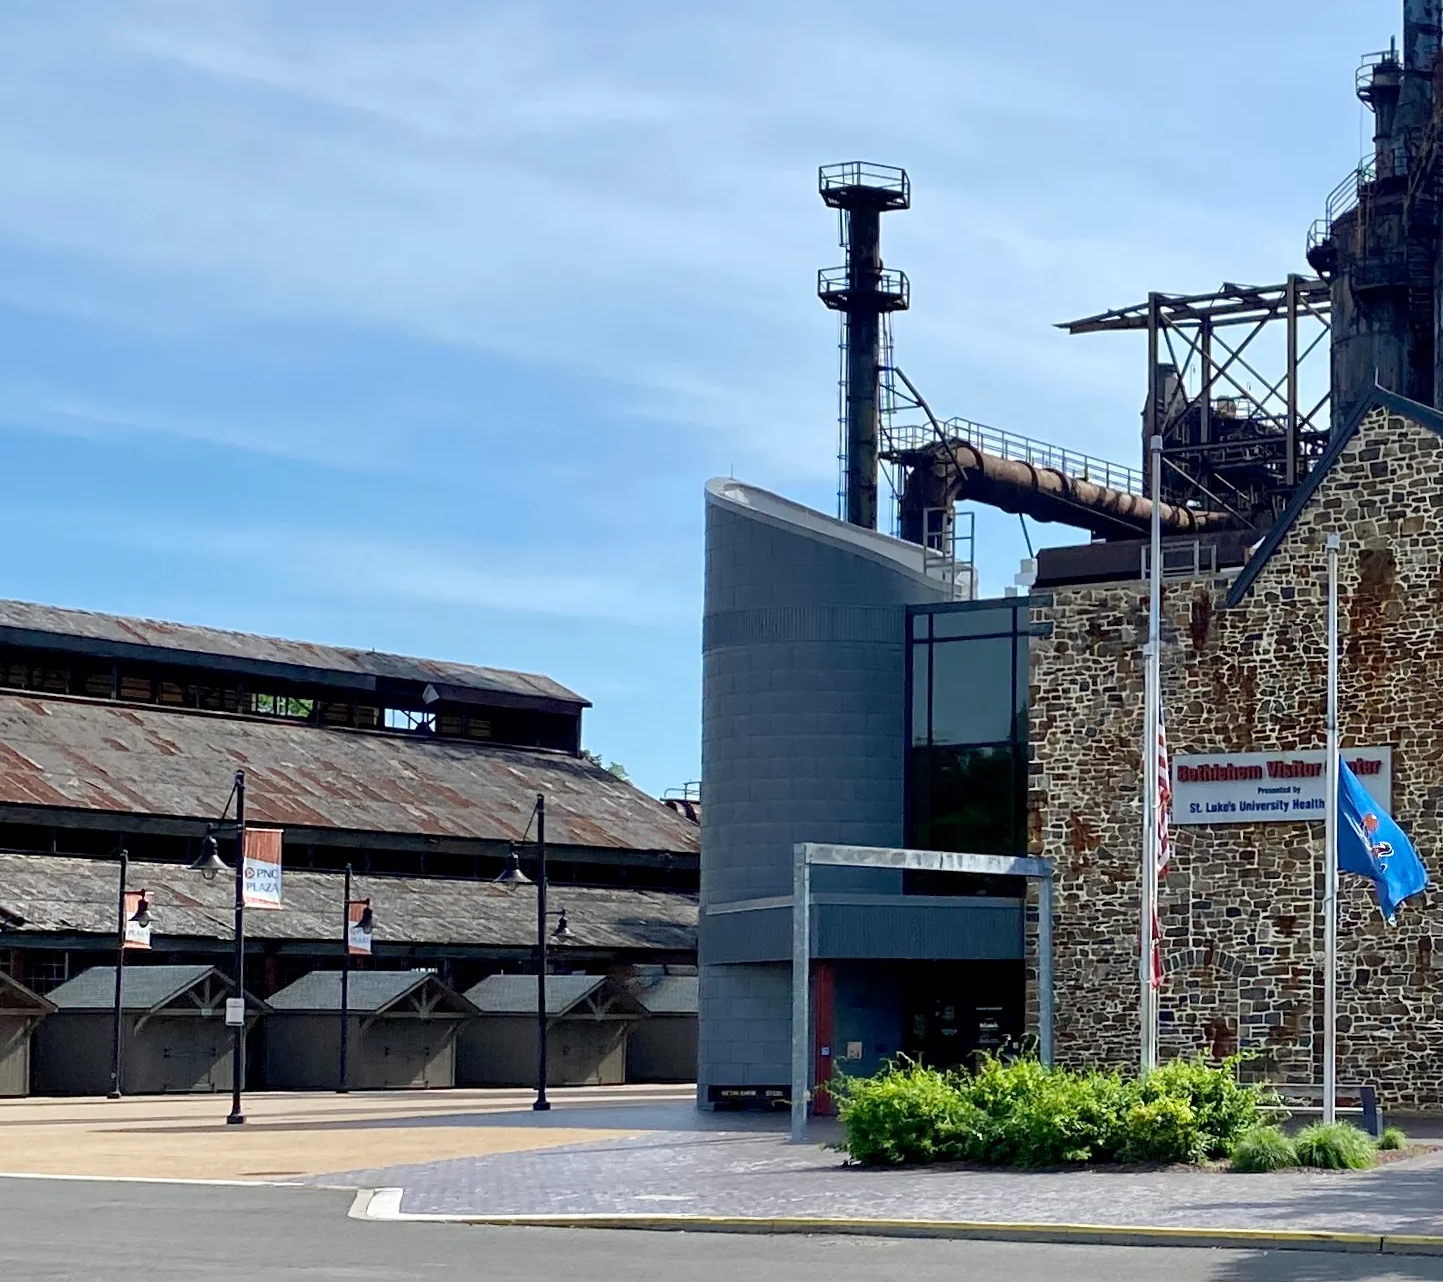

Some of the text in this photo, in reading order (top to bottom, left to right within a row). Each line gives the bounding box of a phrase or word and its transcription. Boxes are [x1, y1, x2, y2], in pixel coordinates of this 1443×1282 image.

[1177, 763, 1263, 782] Bethlehem
[1266, 760, 1322, 778] Visitor
[1292, 786, 1301, 794] by
[1190, 798, 1325, 813] St. Luke's University Health
[256, 869, 279, 879] PNC
[246, 882, 279, 893] PLAZA
